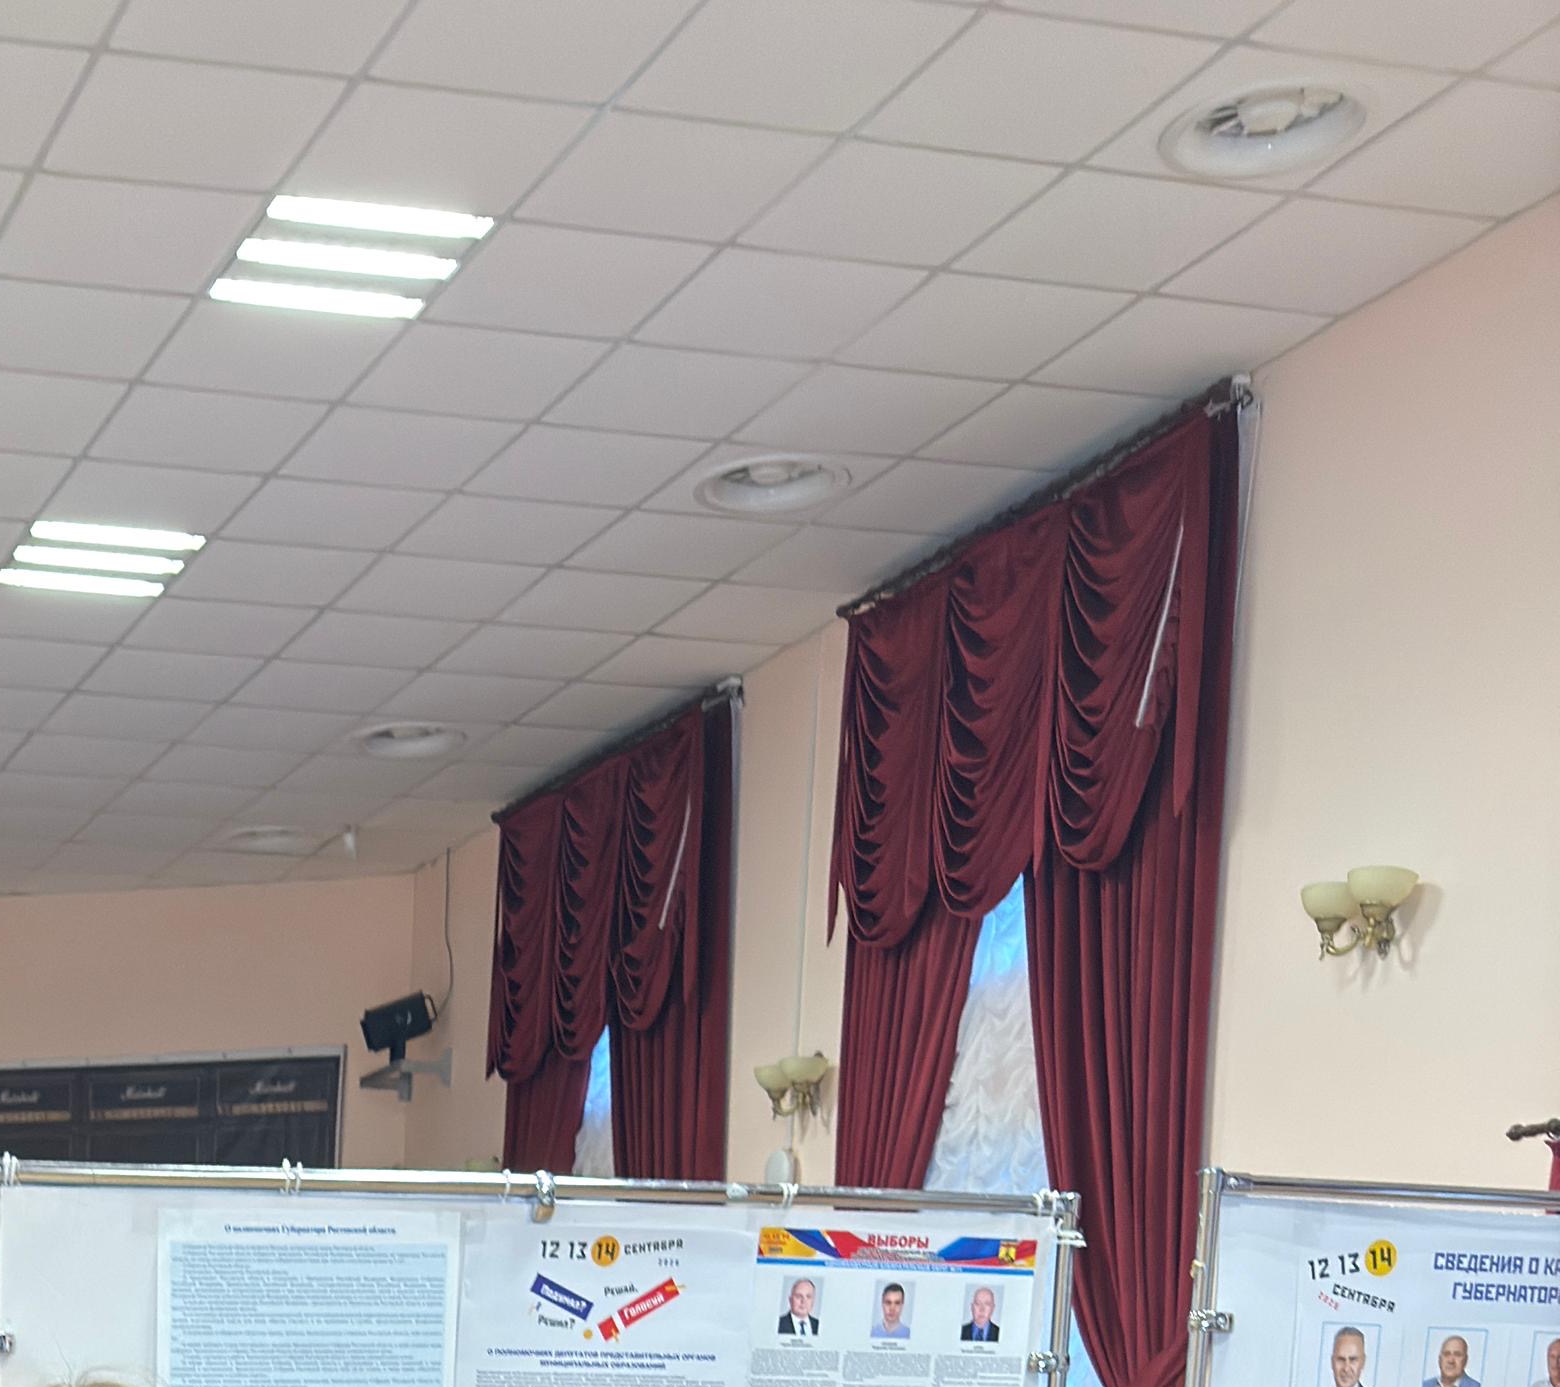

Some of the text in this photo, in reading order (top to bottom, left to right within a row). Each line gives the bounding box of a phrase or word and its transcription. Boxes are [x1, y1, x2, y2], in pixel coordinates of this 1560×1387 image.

[541, 1240, 560, 1259] 12
[568, 1240, 587, 1260] 13
[597, 1242, 616, 1261] 14
[868, 1233, 929, 1249] ВЫБОРЫ
[1308, 1246, 1392, 1280] 12 13 14
[1433, 1252, 1524, 1274] СВЕДЕНИЯ
[1528, 1256, 1540, 1275] О
[1332, 1283, 1396, 1313] СЕНТЯБРЯ
[1452, 1281, 1560, 1305] ГУБЕРНАТОР
